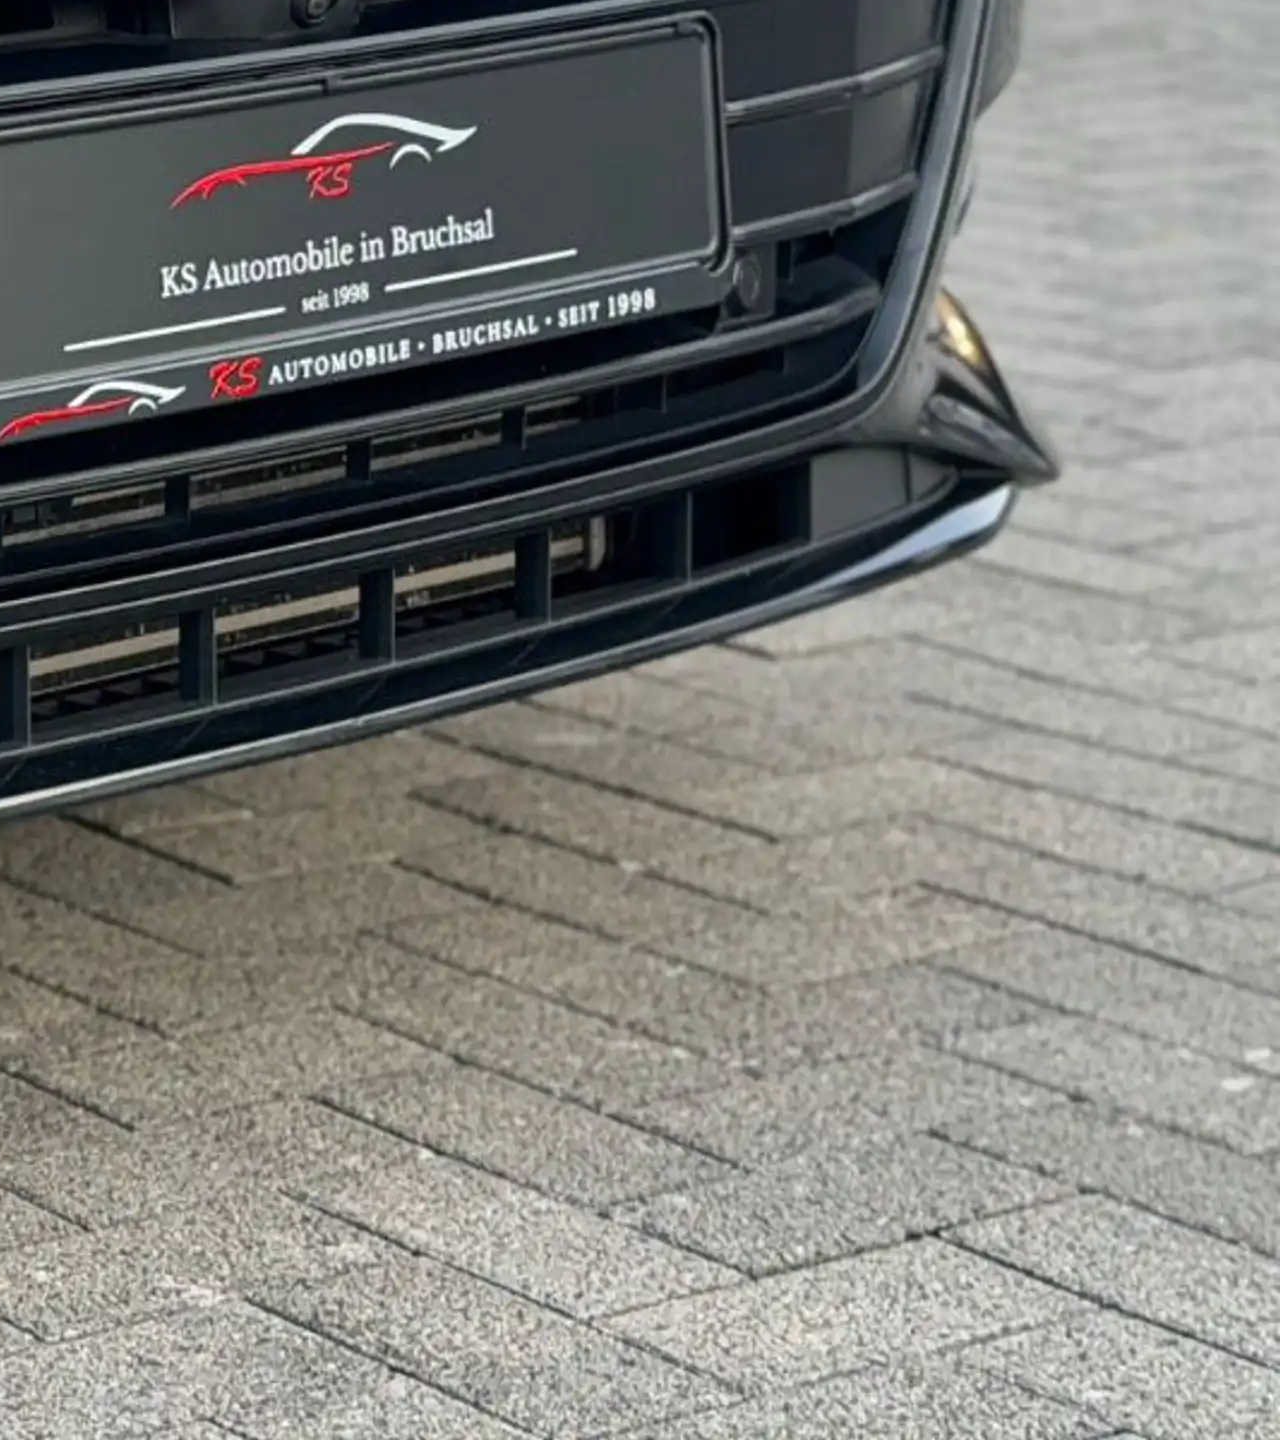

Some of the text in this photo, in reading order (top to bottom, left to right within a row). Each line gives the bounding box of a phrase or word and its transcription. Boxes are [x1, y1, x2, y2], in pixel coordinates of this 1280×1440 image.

[306, 164, 352, 199] KS
[160, 206, 496, 299] KS Automobile in Bruchsal
[301, 281, 370, 314] seit 1998
[208, 286, 657, 401] KS AUTOMOBILE BRUCHSAL SEIT 1998
